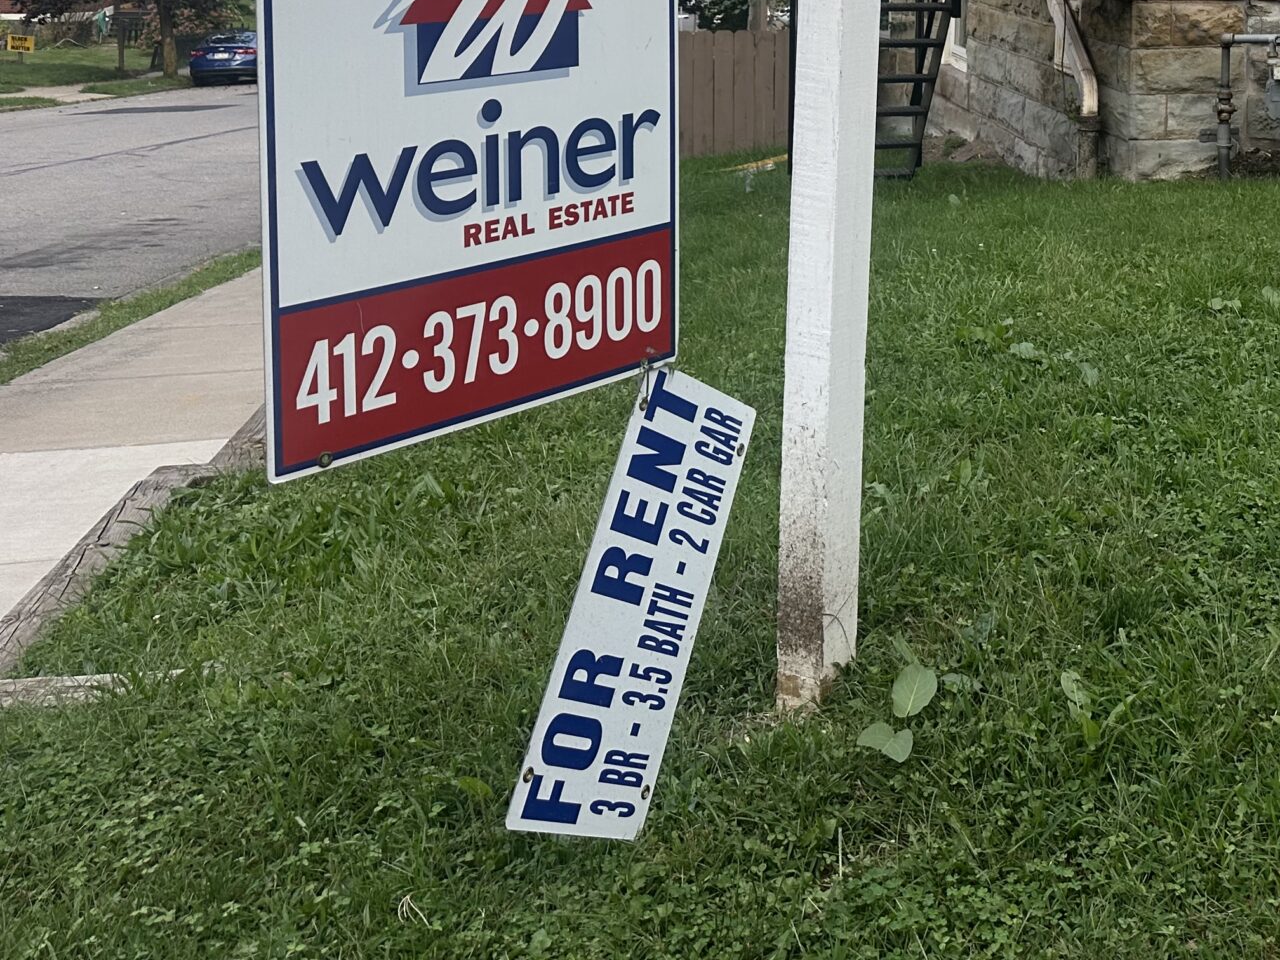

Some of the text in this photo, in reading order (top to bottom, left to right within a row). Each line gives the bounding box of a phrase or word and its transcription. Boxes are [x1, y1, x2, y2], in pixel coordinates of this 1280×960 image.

[299, 98, 661, 237] weiner
[464, 191, 635, 247] REAL ESTATE
[695, 407, 743, 467] GAR
[677, 467, 727, 525] CAR
[668, 527, 710, 556] 2
[520, 369, 700, 826] FOR RENT
[637, 582, 695, 658] BATH
[621, 662, 673, 711] 3.5
[597, 749, 650, 790] BR
[588, 798, 637, 819] 3
